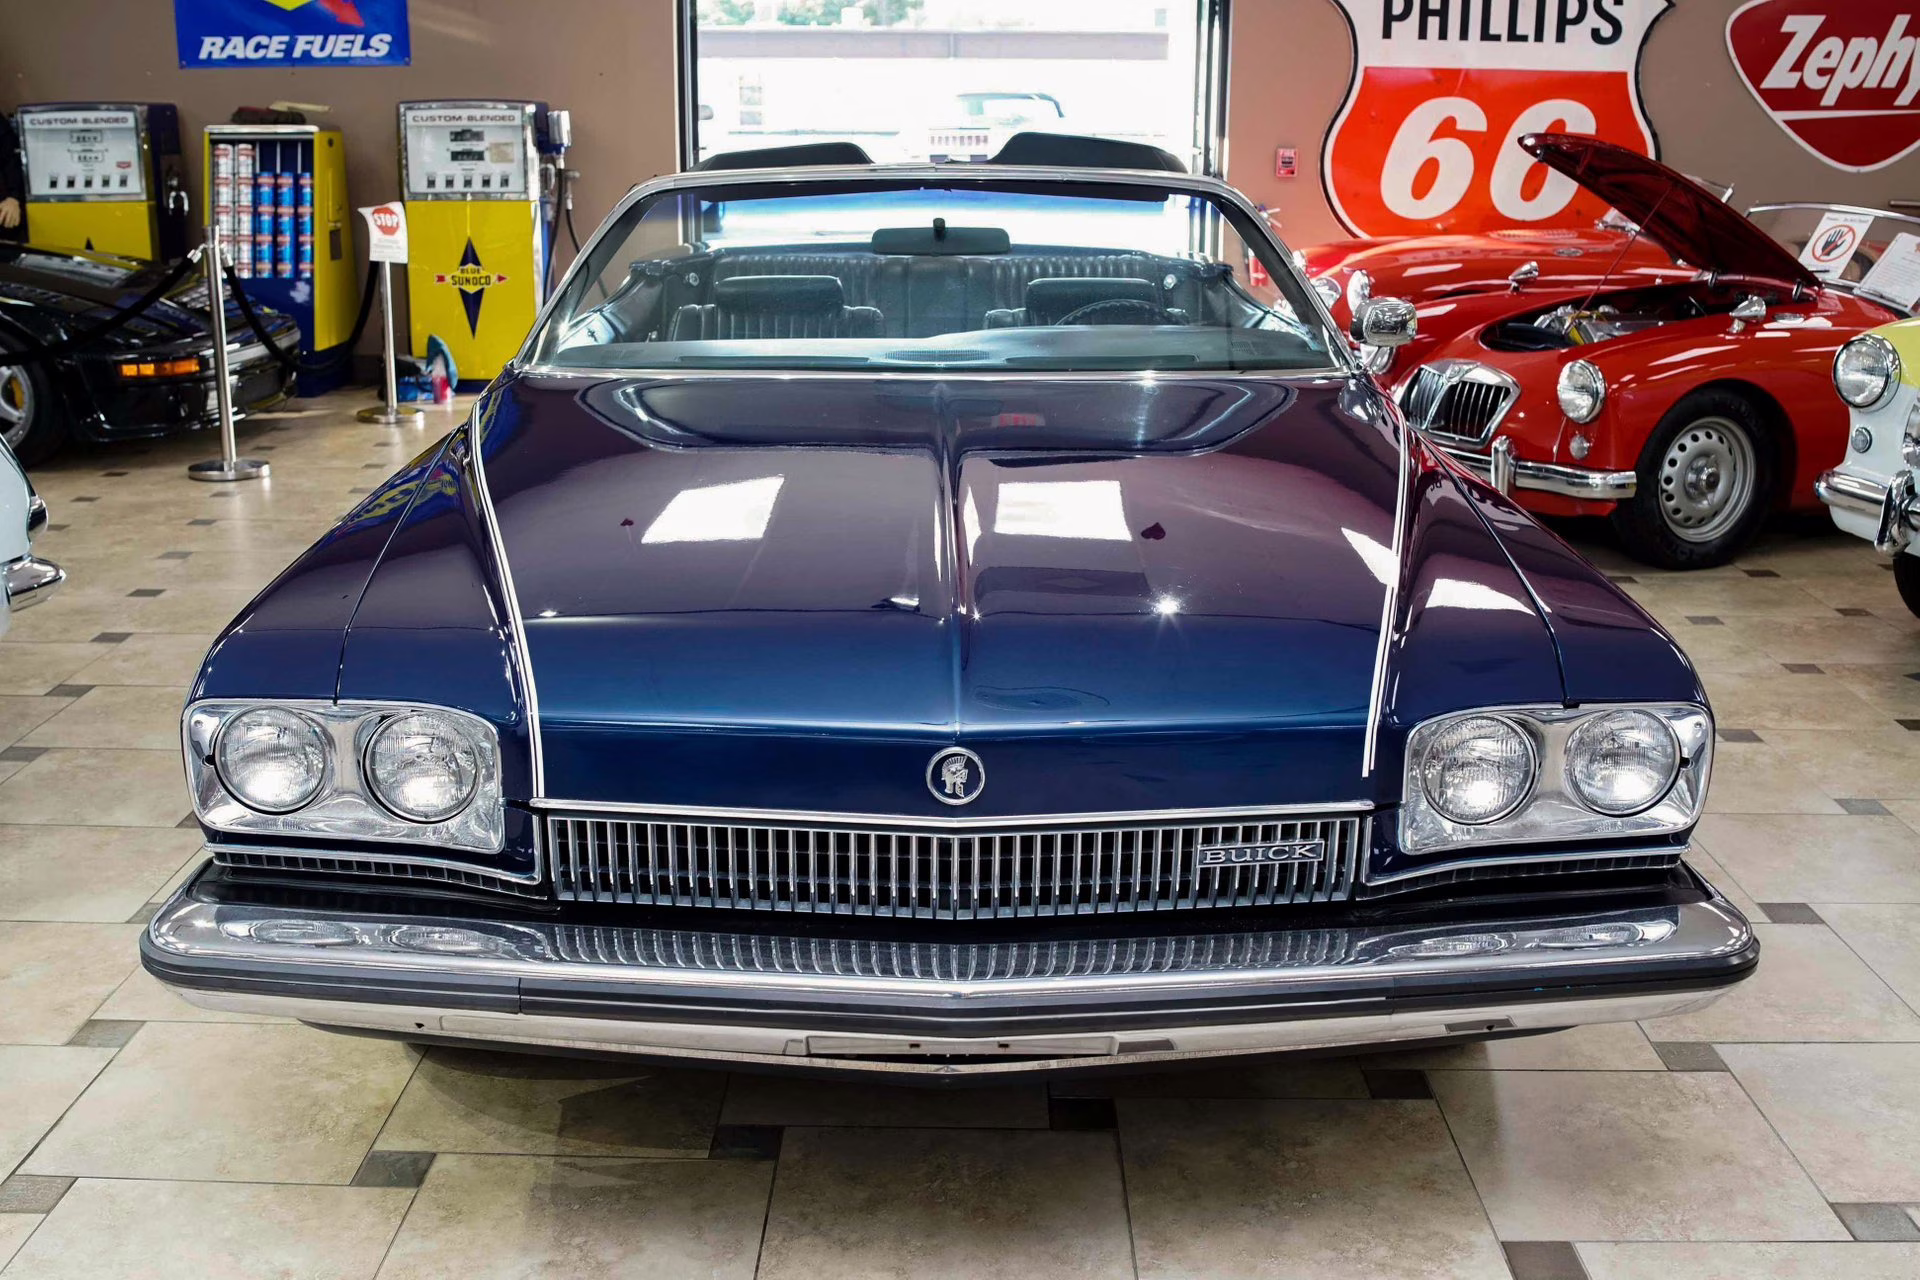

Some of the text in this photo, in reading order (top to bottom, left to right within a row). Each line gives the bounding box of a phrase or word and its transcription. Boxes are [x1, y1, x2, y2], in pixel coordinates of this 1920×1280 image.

[1382, 0, 1623, 45] PHILLIPS
[198, 33, 393, 60] RACE FUELS
[412, 114, 516, 123] CUSTOM-BLENDED
[1380, 96, 1597, 221] 66
[373, 212, 399, 228] STOP
[451, 275, 491, 286] SUNOCO
[1202, 844, 1317, 864] BUICK
